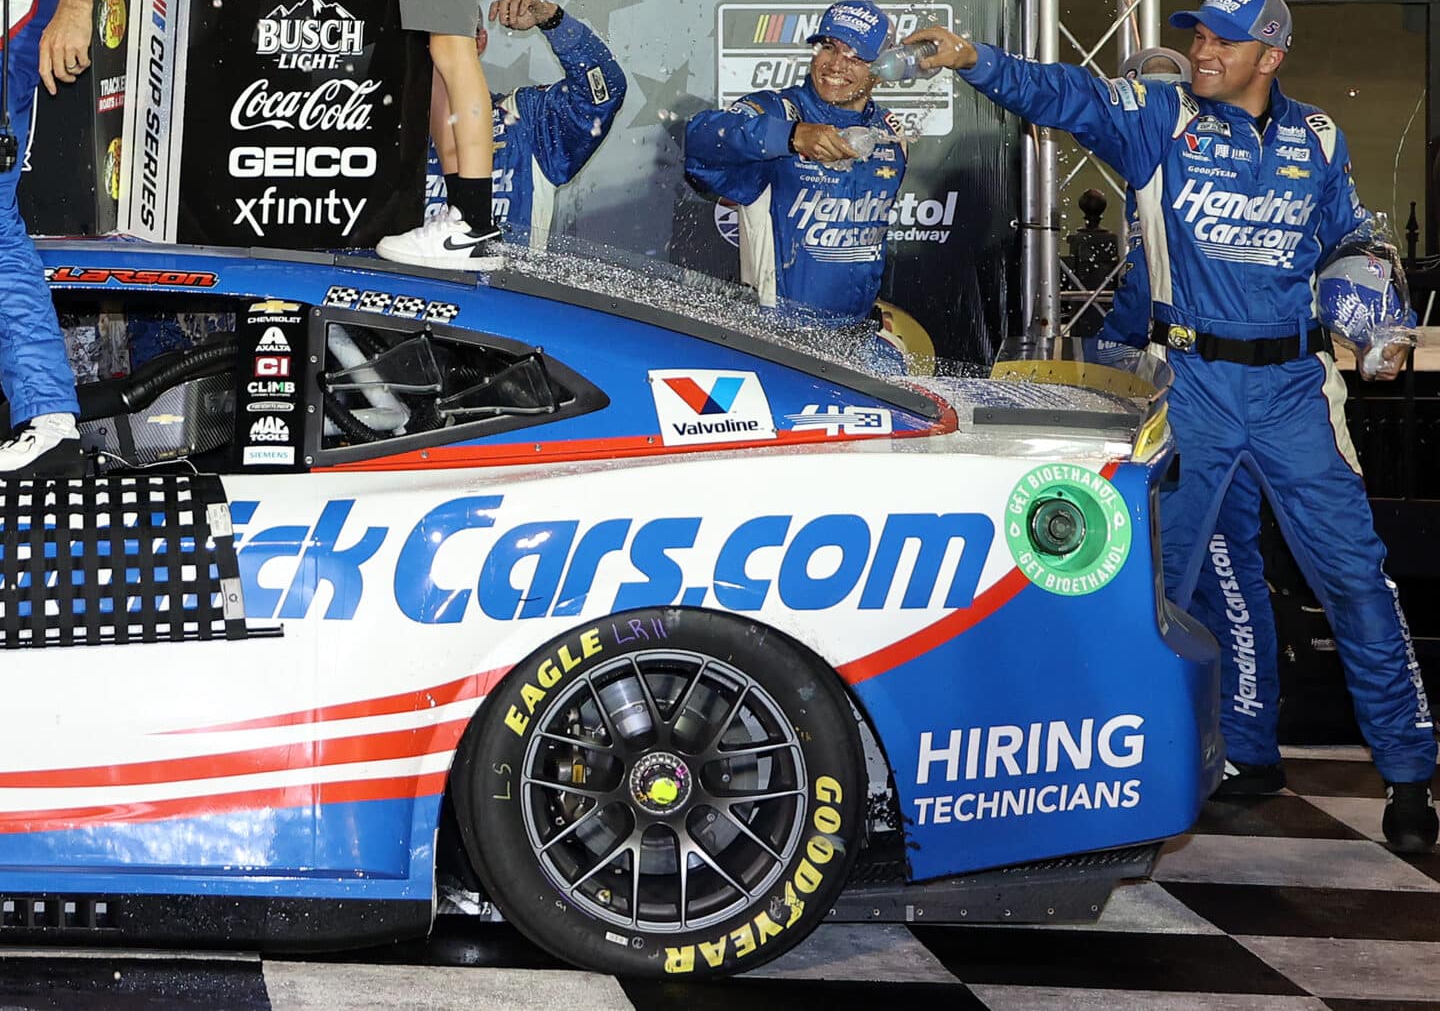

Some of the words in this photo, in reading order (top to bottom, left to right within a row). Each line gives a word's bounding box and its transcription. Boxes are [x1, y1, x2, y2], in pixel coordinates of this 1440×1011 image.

[255, 18, 365, 56] BUSCH
[1261, 20, 1280, 38] 5
[146, 33, 165, 102] CUP
[277, 53, 342, 70] LIGHT
[141, 112, 161, 232] SERIES
[228, 146, 377, 178] GEICO
[1187, 164, 1238, 179] GOODYEAR
[232, 186, 368, 237] xfinity
[1171, 177, 1316, 229] Hendrick
[886, 229, 952, 244] eedway
[1193, 215, 1305, 251] Cars.com
[247, 316, 303, 325] CHEVROLET
[254, 344, 292, 353] AXALTA
[246, 380, 296, 394] CLIMB
[249, 415, 290, 435] MAC
[249, 433, 290, 442] TOOLS
[672, 418, 760, 437] Valvoline
[248, 451, 290, 459] SIEMENS
[1009, 485, 1031, 515] GET
[1026, 465, 1117, 506] BIOETHANOL
[1018, 549, 1046, 581] GET
[1044, 542, 1126, 593] BIOETHANOL
[503, 626, 604, 738] EAGLE
[915, 714, 1146, 785] HIRING
[913, 779, 1142, 826] TECHNICIANS
[662, 774, 845, 976] GOODYEAR
